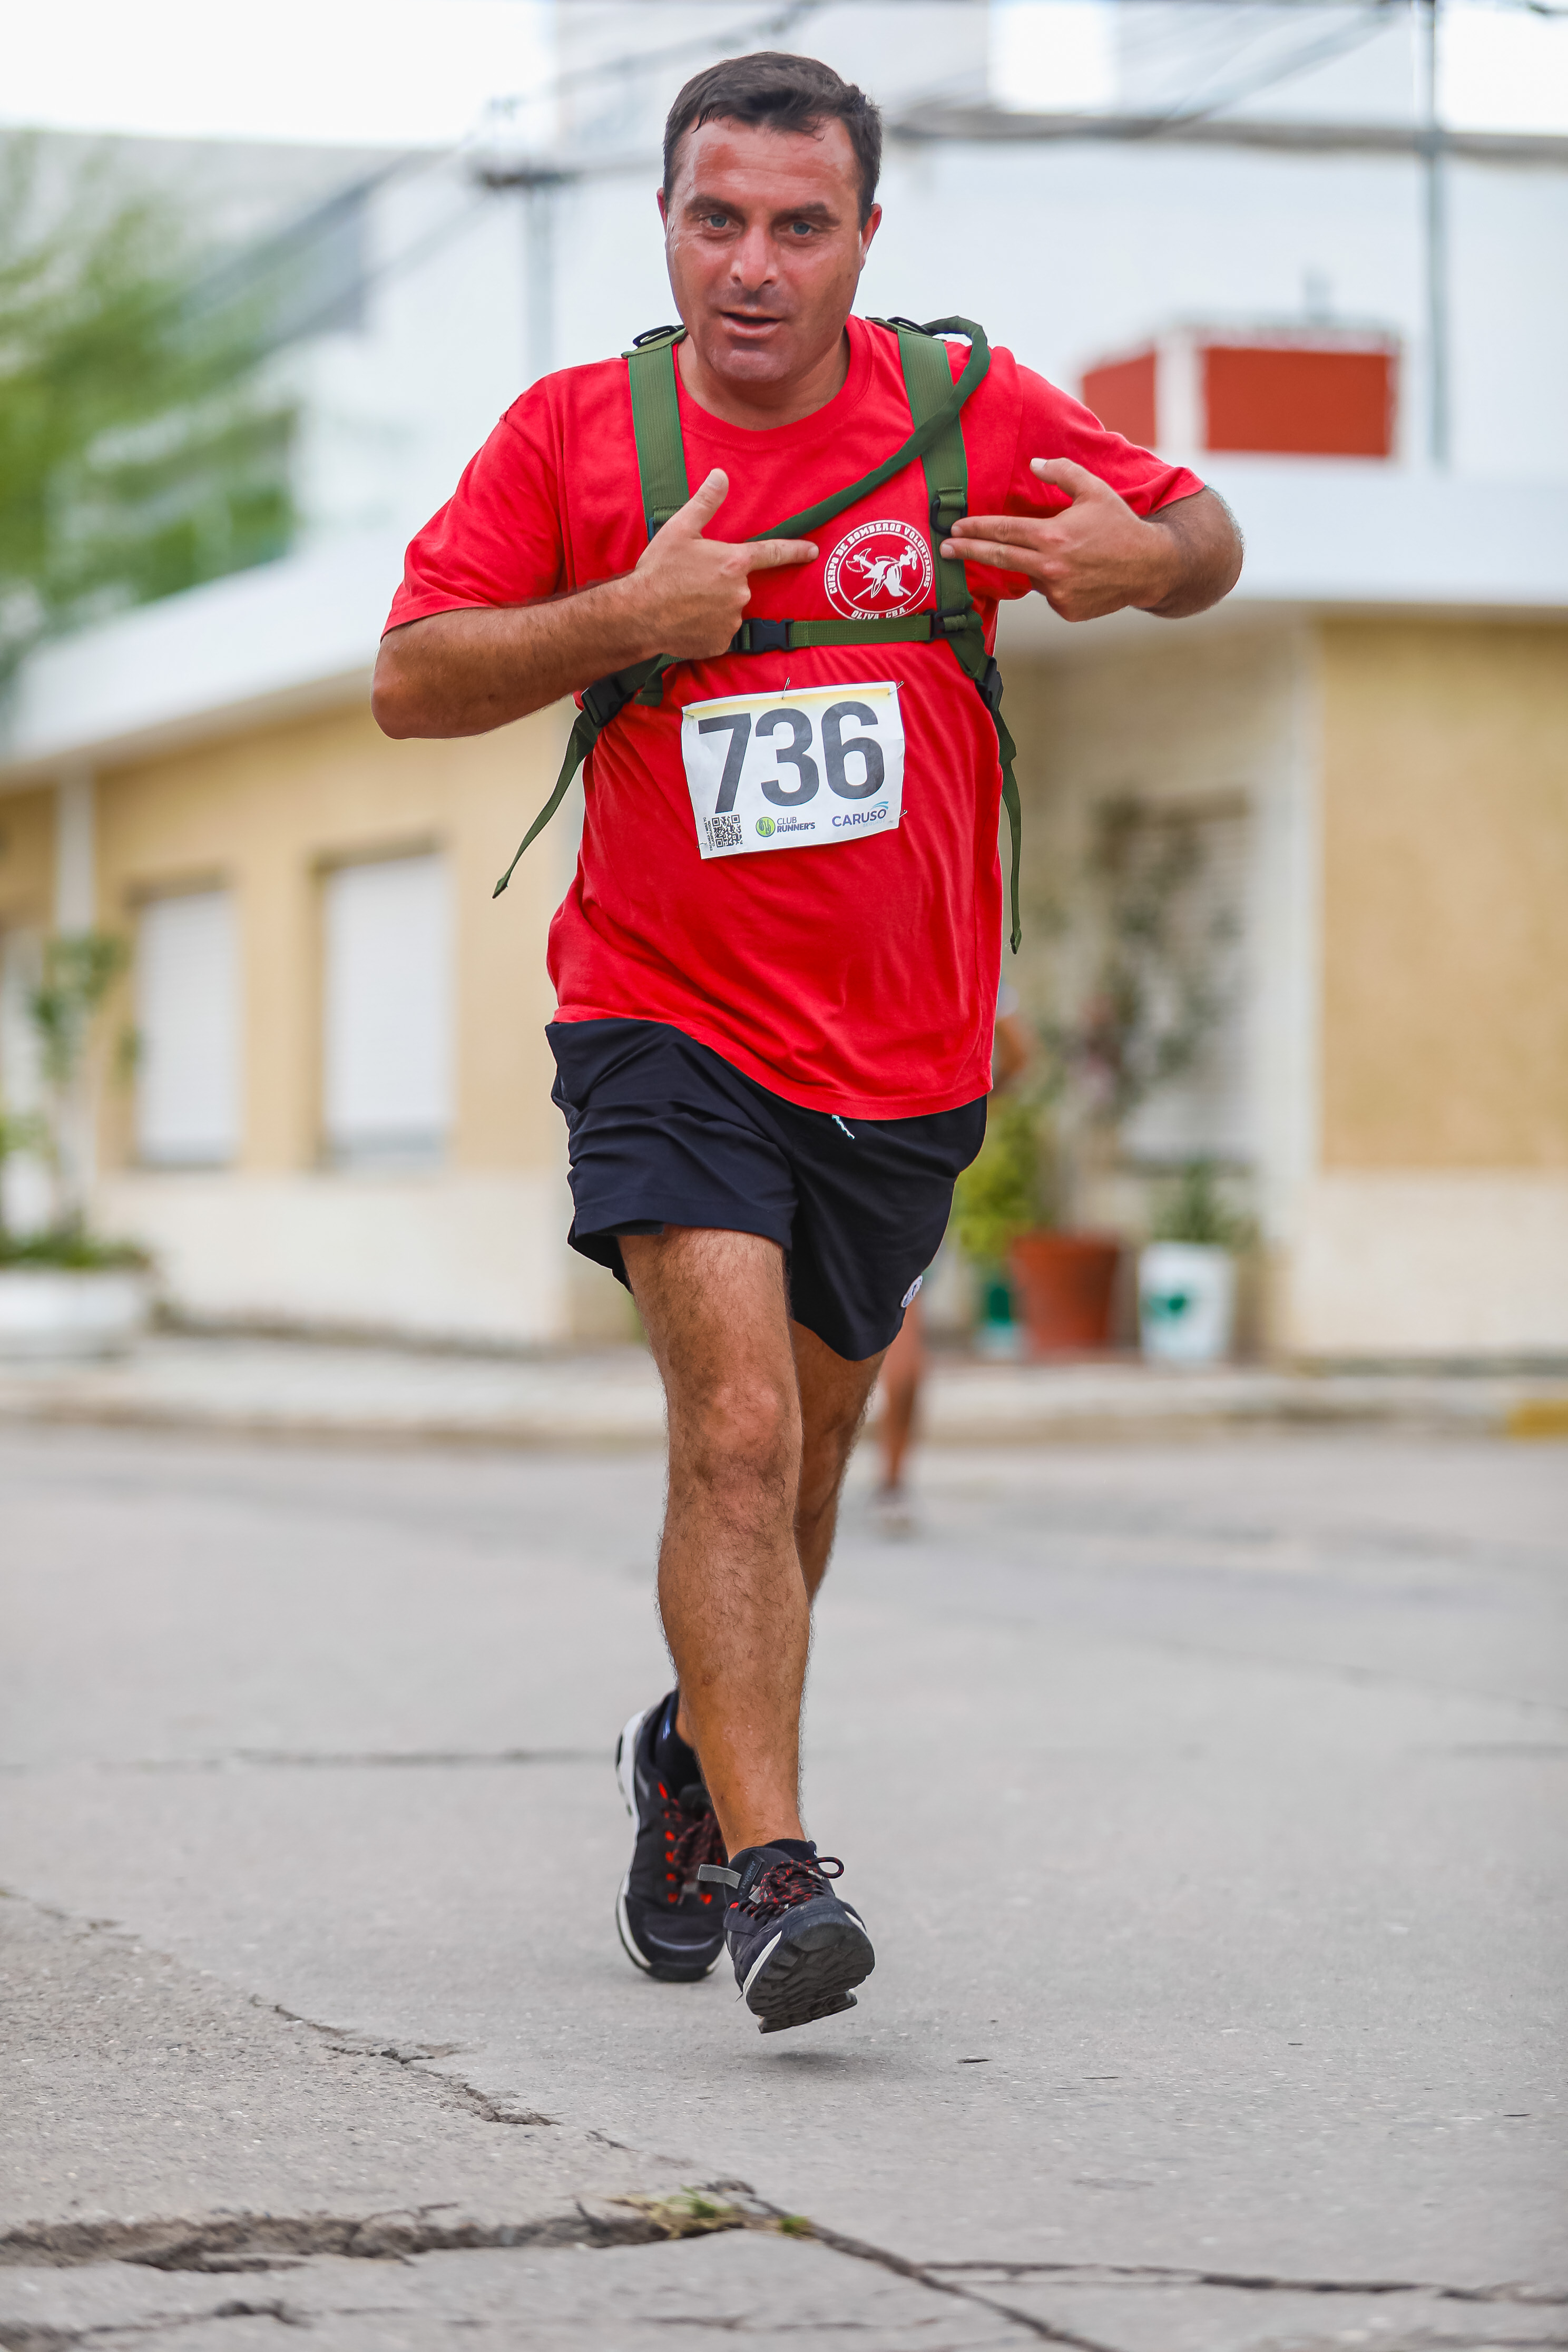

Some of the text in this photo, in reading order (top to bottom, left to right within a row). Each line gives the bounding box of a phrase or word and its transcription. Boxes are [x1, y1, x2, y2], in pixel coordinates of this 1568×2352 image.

[828, 523, 932, 594] CUERPO DE BOMBEROS VOLUNTARIOS
[851, 610, 879, 620] OLIVA
[698, 701, 885, 814] 736
[777, 822, 815, 832] RUNNER'S
[831, 809, 887, 827] CARUSO
[740, 1861, 756, 1888] Topper
